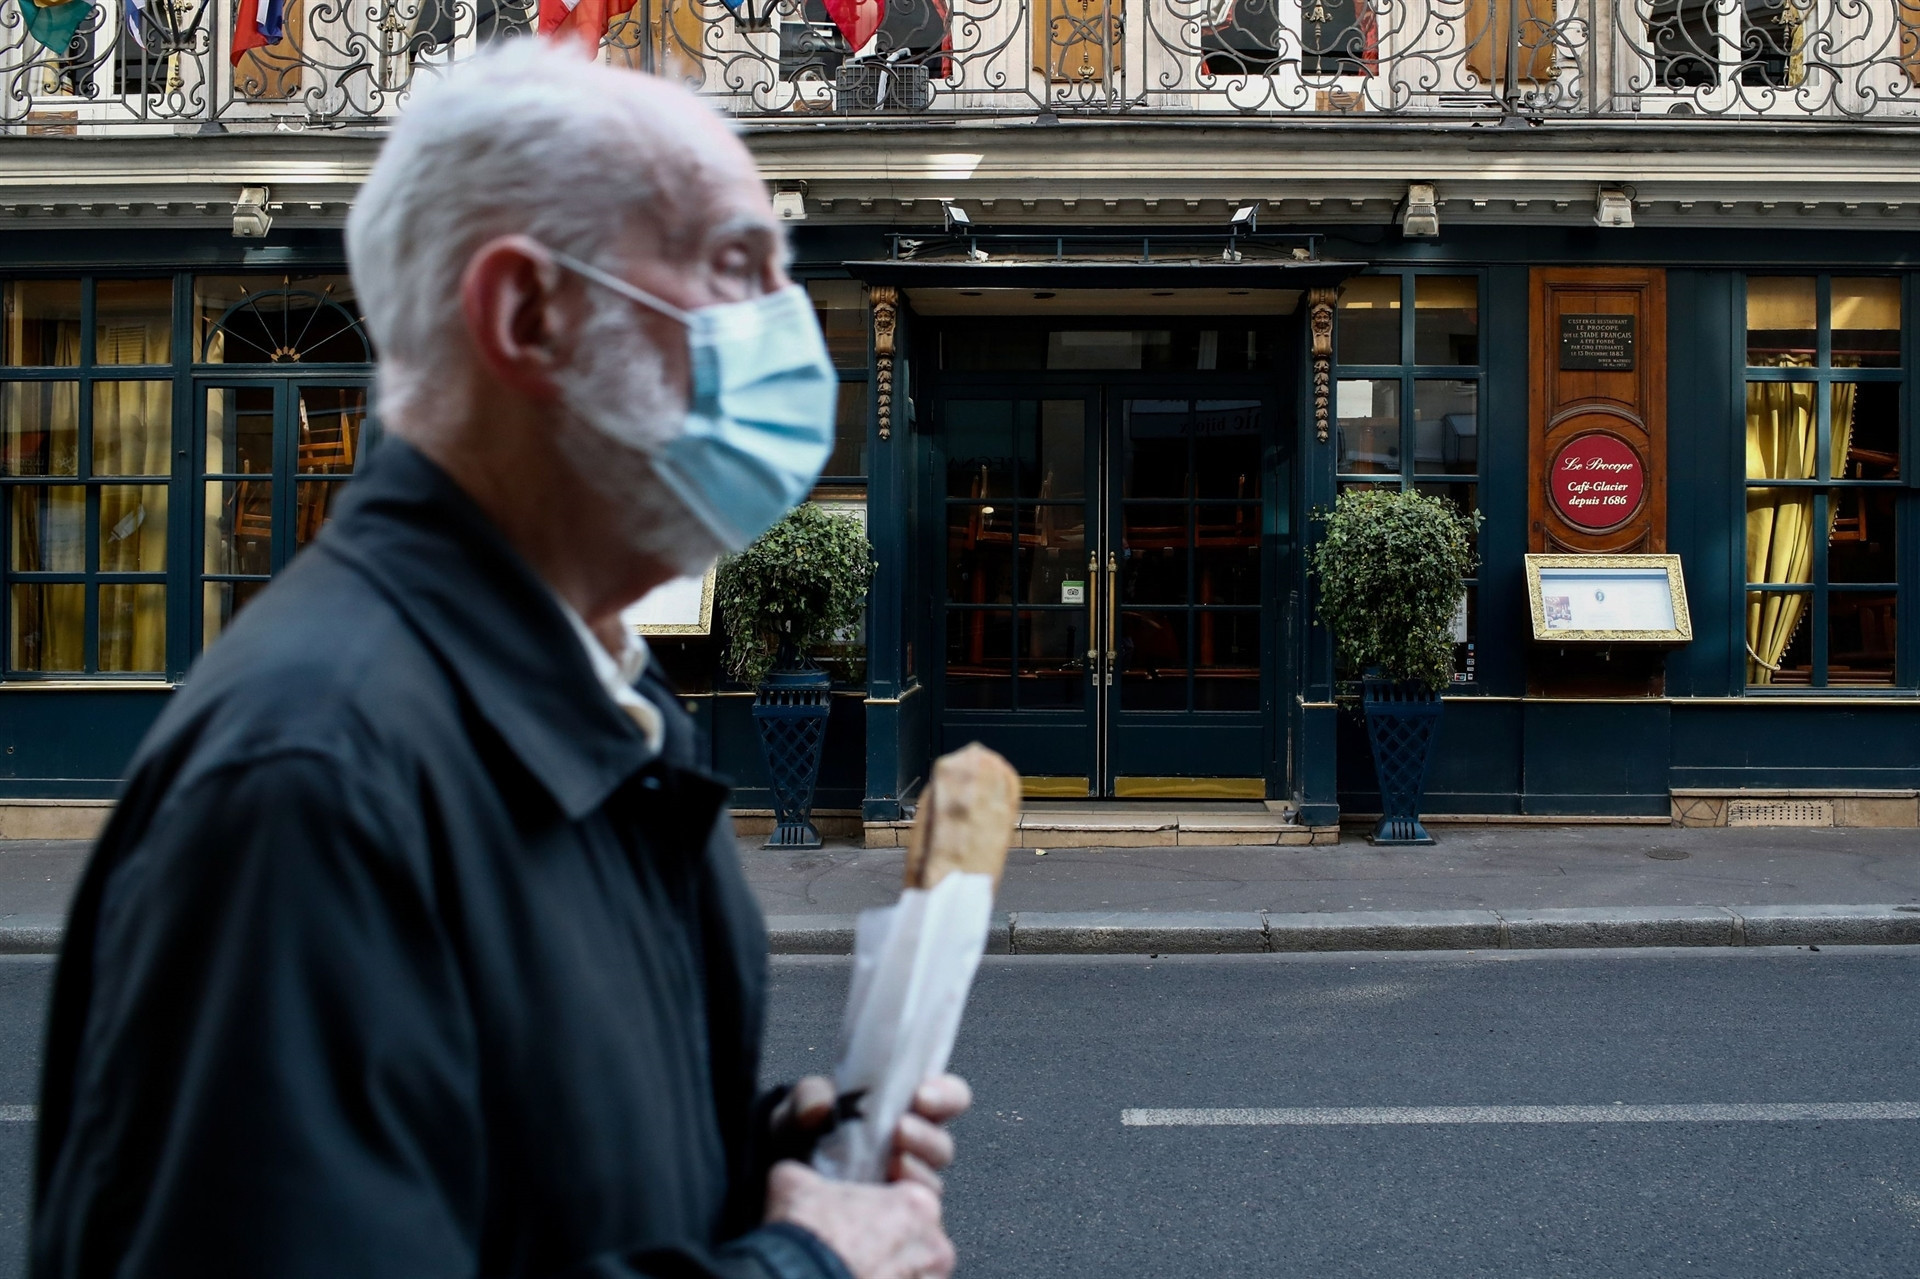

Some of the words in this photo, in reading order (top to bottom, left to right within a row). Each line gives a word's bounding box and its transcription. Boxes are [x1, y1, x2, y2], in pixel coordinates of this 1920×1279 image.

[1561, 457, 1583, 470] Le
[1586, 457, 1633, 473] Procope
[1568, 481, 1628, 494] Café-Glacier
[1569, 496, 1599, 507] depuis
[1603, 495, 1627, 505] 1686
